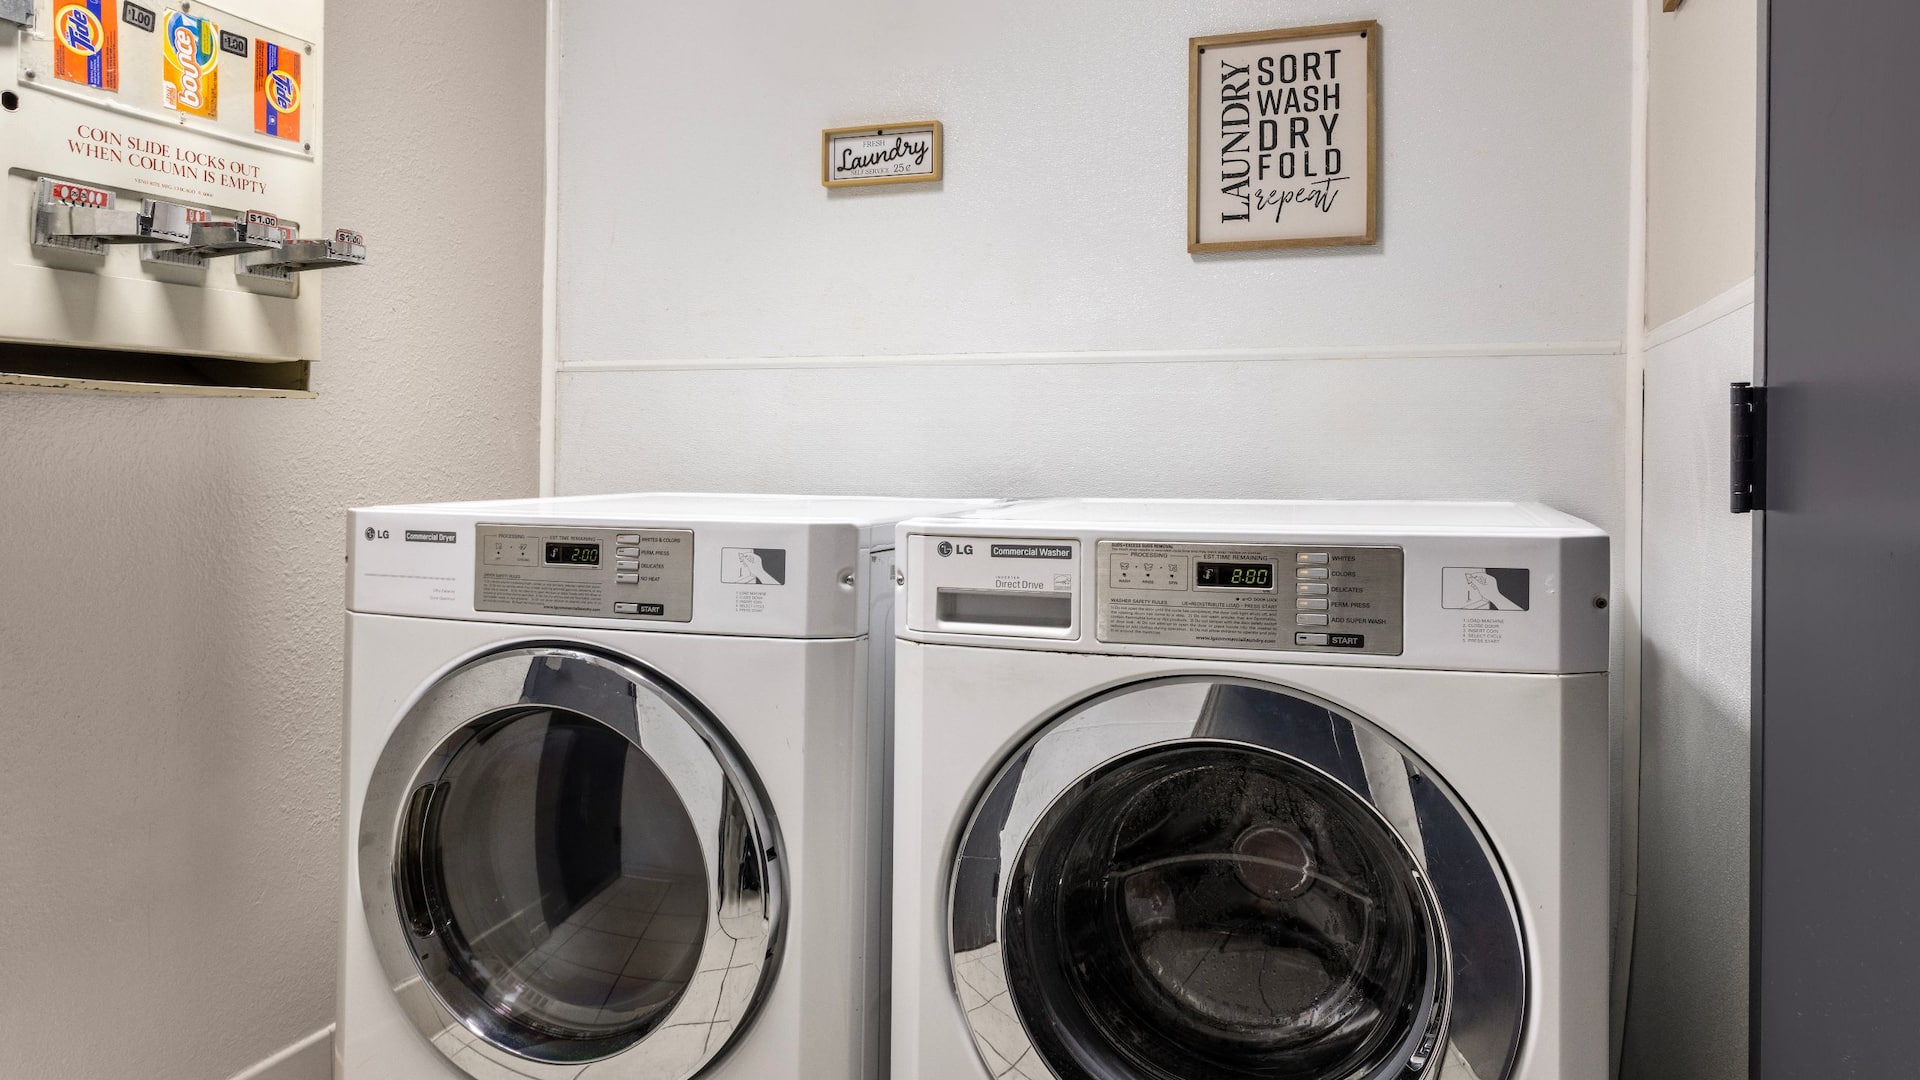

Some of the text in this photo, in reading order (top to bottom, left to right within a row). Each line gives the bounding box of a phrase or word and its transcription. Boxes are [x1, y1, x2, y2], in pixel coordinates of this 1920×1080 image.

[68, 9, 96, 52] Tide
[175, 29, 200, 108] bounce
[1257, 49, 1342, 86] SORT
[271, 72, 292, 110] Tide
[1257, 83, 1340, 117] WASH
[863, 139, 886, 148] FRESH
[1221, 60, 1250, 224] LAUNDRY
[1259, 113, 1339, 151] DRY
[68, 139, 267, 195] WHEN COLUMN IS EMPTY
[77, 124, 260, 178] COIN SLIDE LOCKS OUT
[836, 137, 929, 172] Laundry
[1259, 148, 1341, 180] FOLD
[1254, 176, 1350, 223] repeat
[250, 214, 276, 226] $1.00
[377, 530, 390, 539] LG
[406, 532, 456, 542] Commercial Dryer
[956, 544, 973, 555] LG
[993, 546, 1070, 558] Commercial Washer
[996, 580, 1044, 590] Direct Drive
[1332, 636, 1358, 645] START
